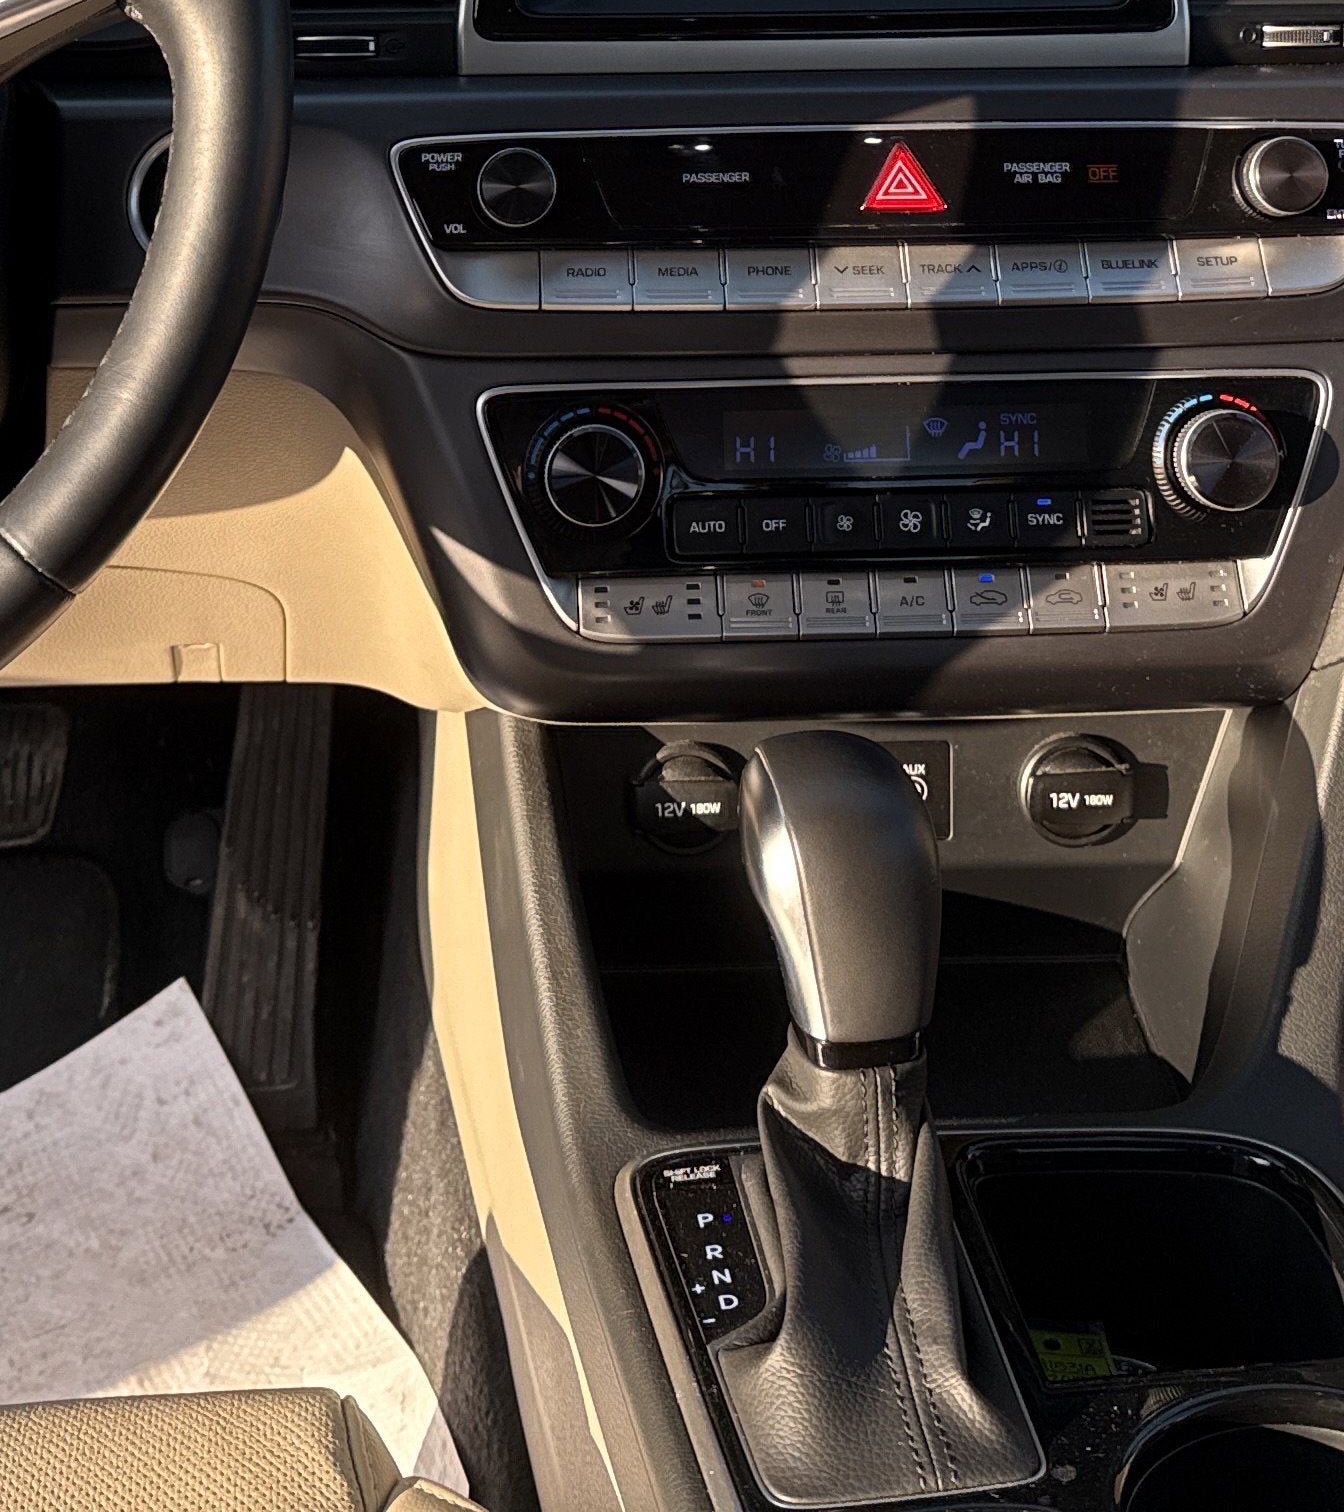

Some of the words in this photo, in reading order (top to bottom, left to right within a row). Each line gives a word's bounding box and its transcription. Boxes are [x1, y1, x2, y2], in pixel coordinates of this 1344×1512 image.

[421, 152, 462, 163] POWER
[428, 162, 455, 172] PUSH
[1003, 162, 1071, 174] PASSENGER
[1087, 166, 1119, 181] OFF
[682, 171, 750, 184] PASSENGER
[1013, 173, 1033, 184] AIR
[1038, 173, 1062, 184] BAG
[443, 223, 467, 235] VOL
[1100, 258, 1160, 270] BLUELINK
[1196, 255, 1238, 267] SETUP
[566, 266, 607, 278] RADIO
[657, 265, 699, 277] MEDIA
[747, 265, 792, 277] PHONE
[852, 264, 885, 276] SEEK
[920, 262, 964, 275] TRACK
[999, 412, 1038, 426] SYNC
[762, 518, 787, 532] OFF
[1027, 512, 1064, 527] SYNC
[689, 519, 726, 535] AUTO
[899, 594, 926, 608] A/C
[745, 608, 773, 617] FRONT
[825, 606, 847, 615] REAR
[1049, 791, 1081, 809] 12V
[655, 801, 687, 818] 12V
[663, 1166, 692, 1178] SHIFT
[693, 1164, 722, 1174] LOCK
[670, 1171, 717, 1183] RELEASE
[696, 1212, 714, 1229] P
[704, 1243, 725, 1260] R
[711, 1267, 733, 1285] N
[717, 1293, 739, 1310] D
